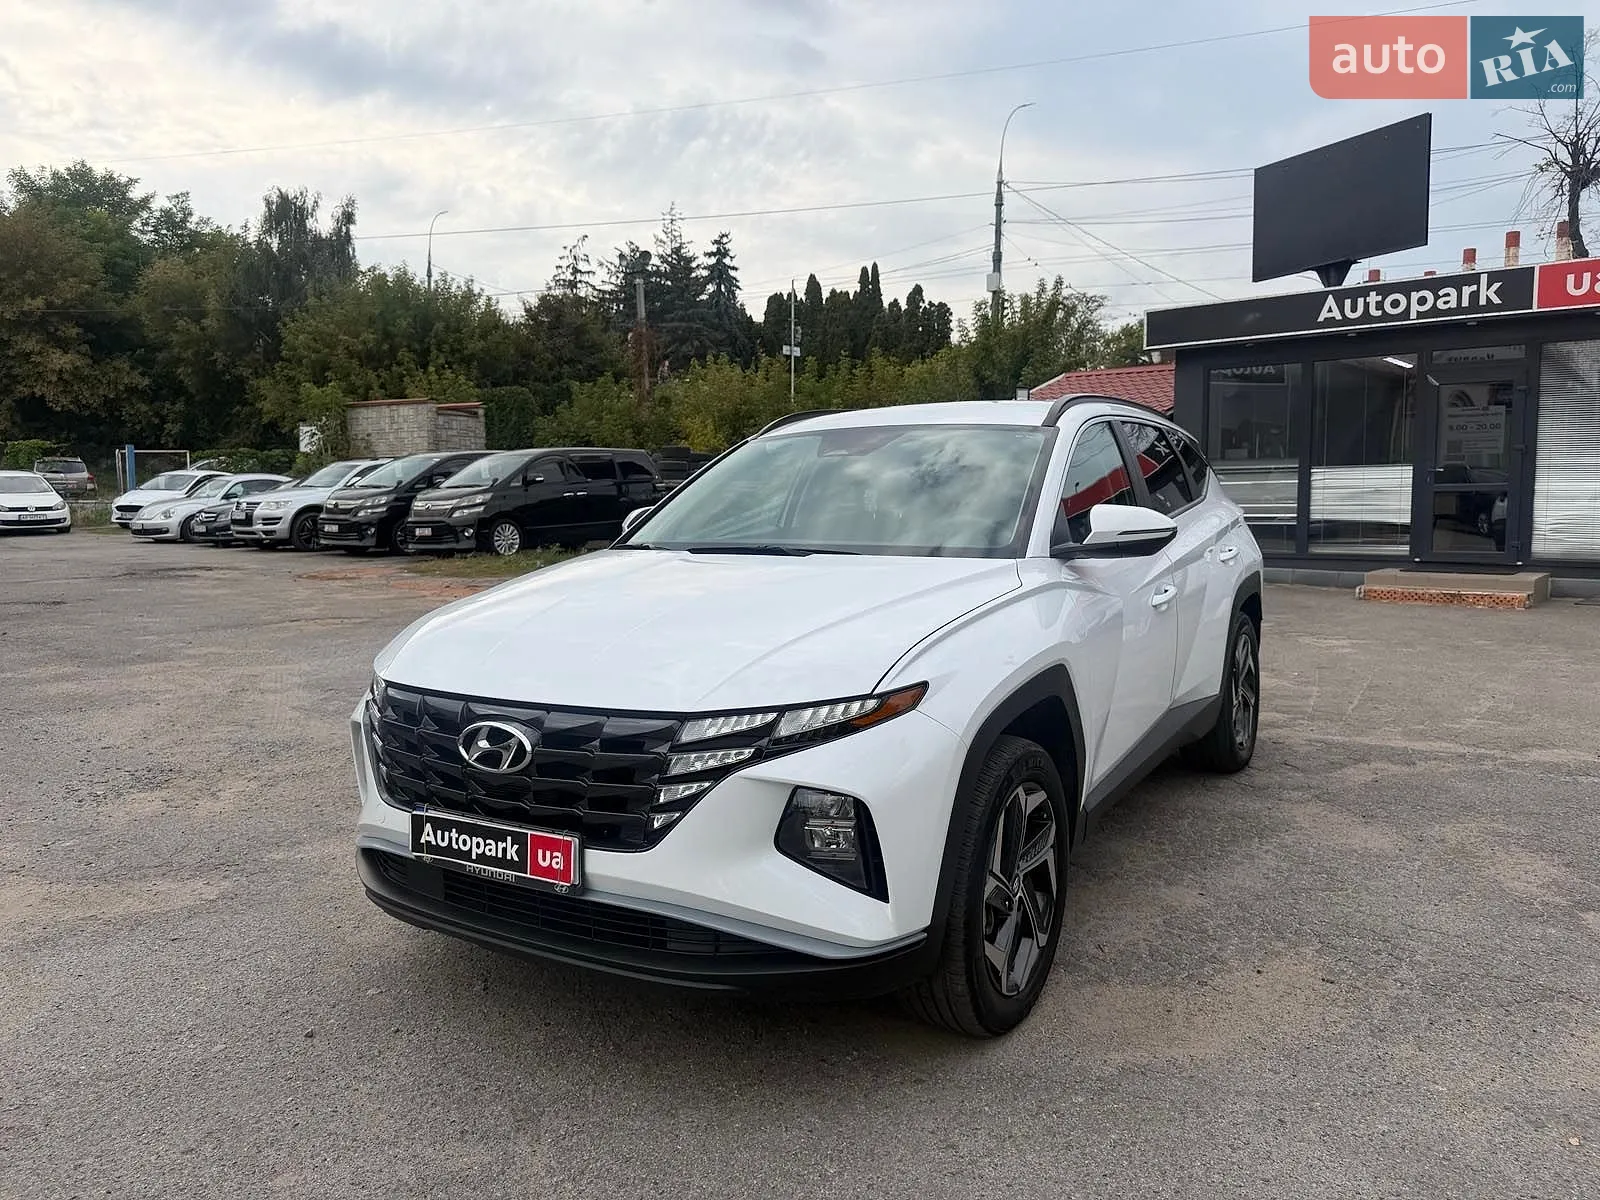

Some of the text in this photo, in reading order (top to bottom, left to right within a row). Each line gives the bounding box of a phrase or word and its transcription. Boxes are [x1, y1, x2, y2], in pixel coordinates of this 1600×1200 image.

[1316, 273, 1503, 321] Autopark
[419, 822, 564, 871] Autopark ua
[465, 863, 516, 883] HYUNDAI
